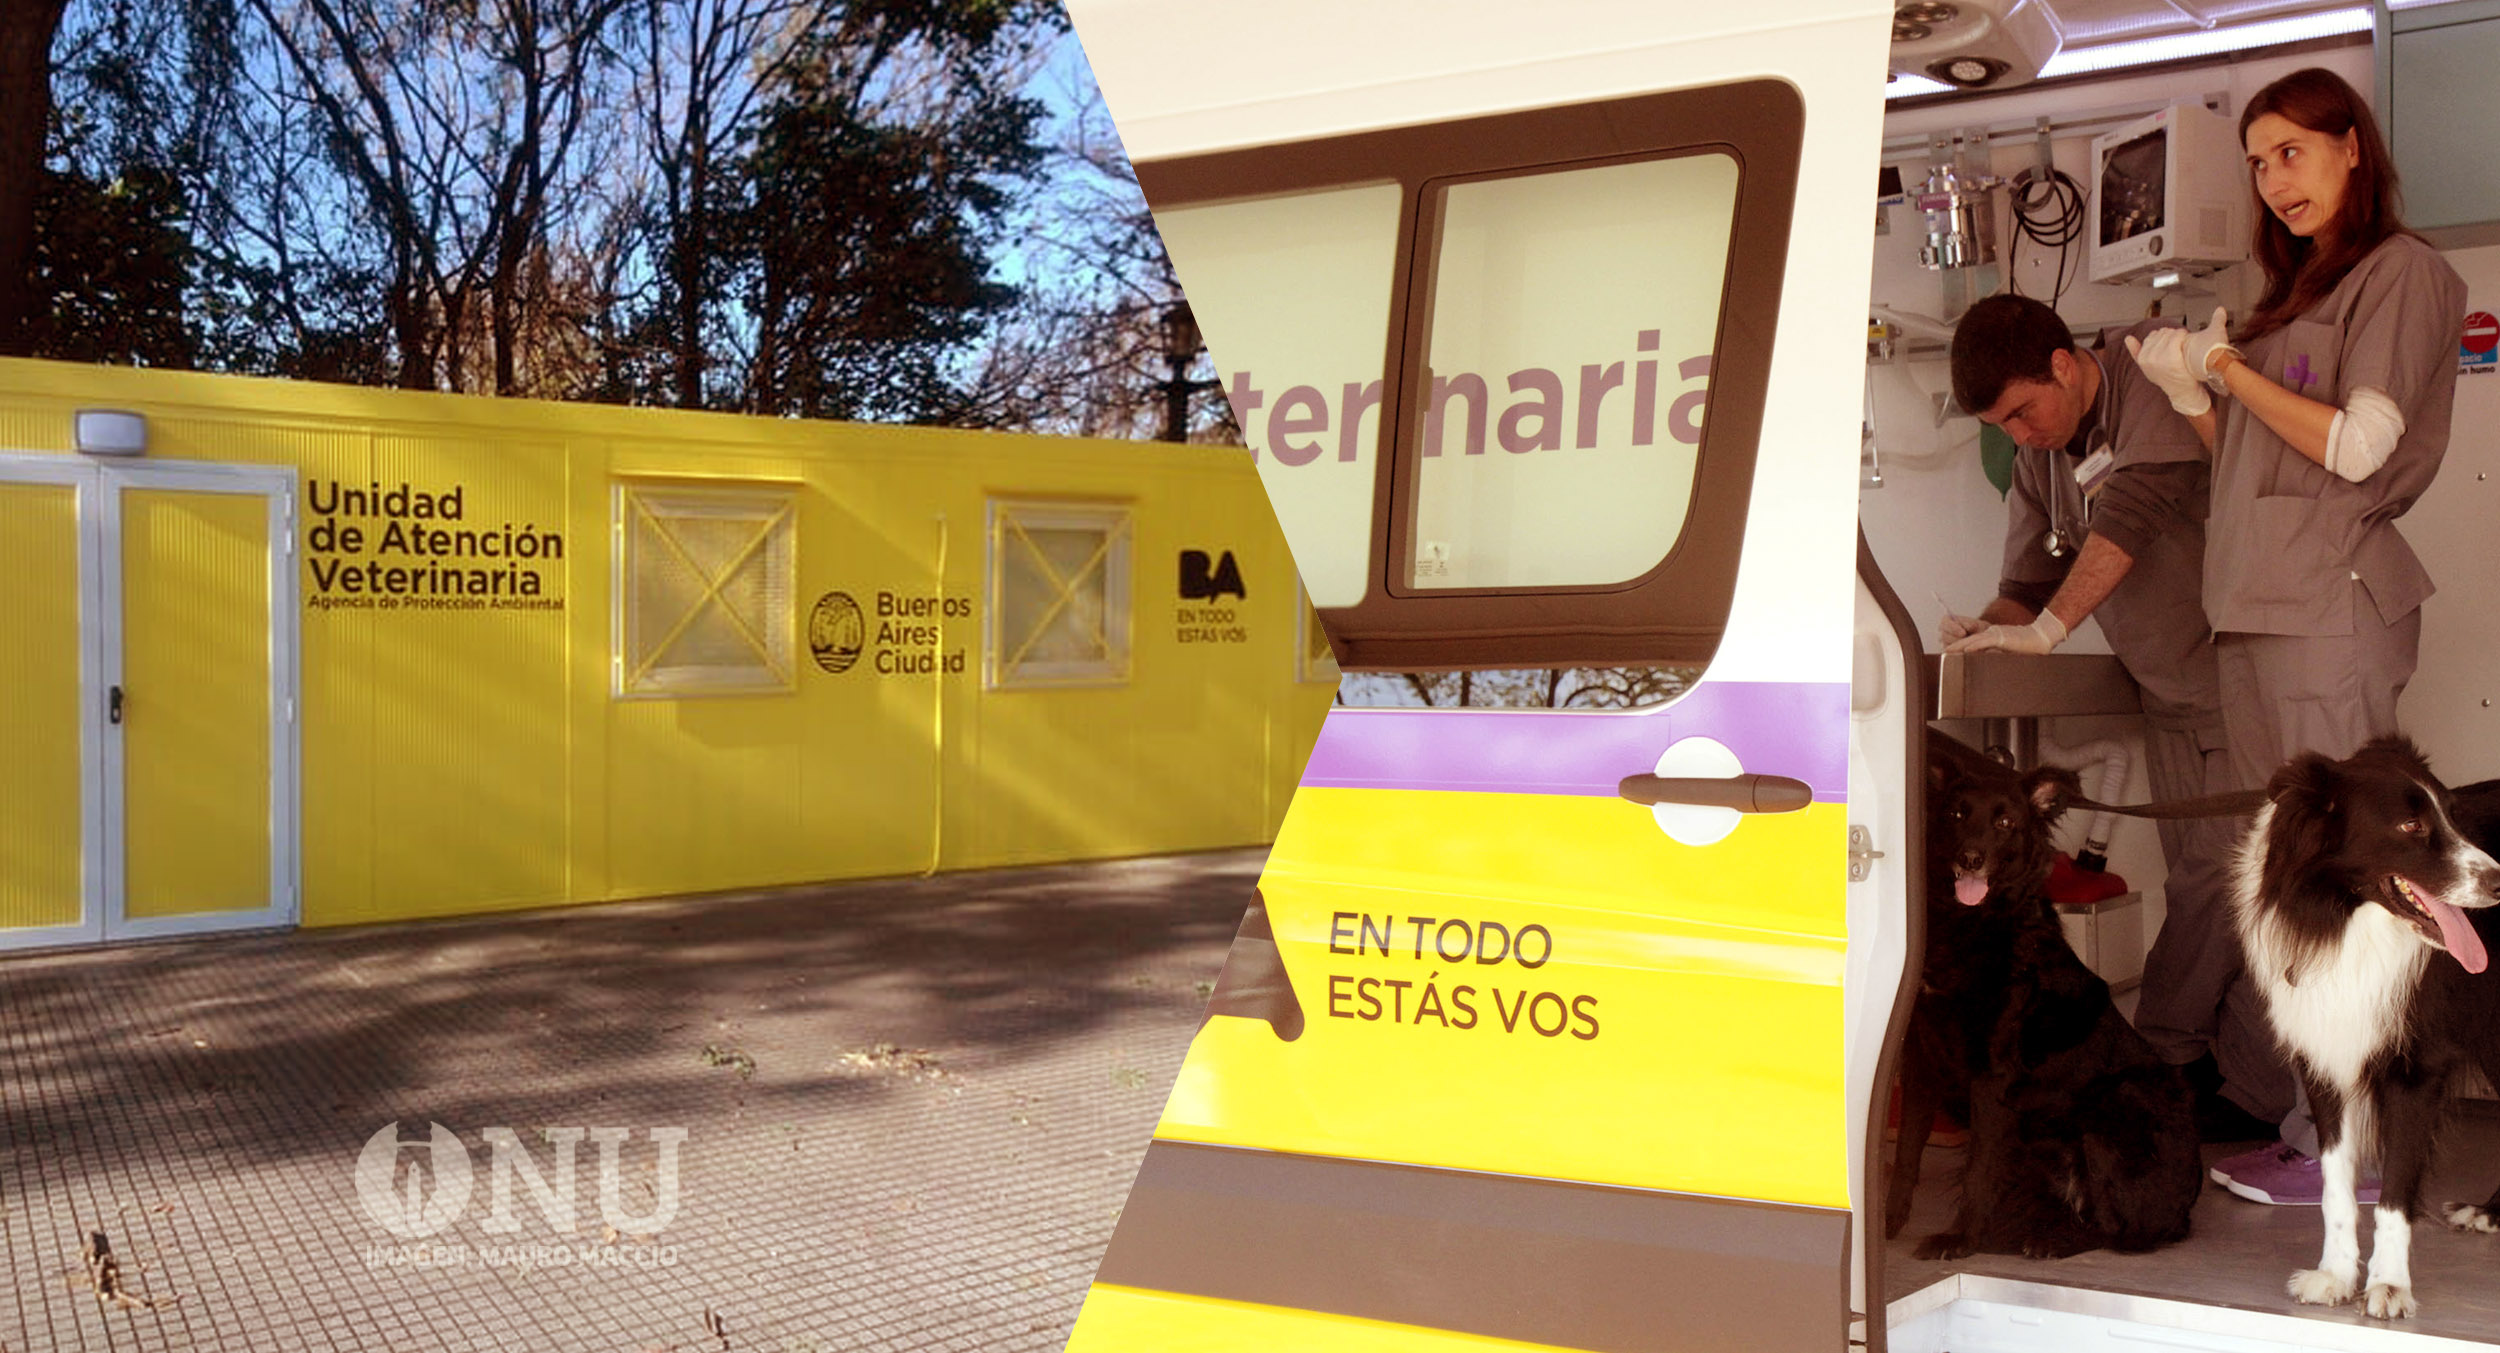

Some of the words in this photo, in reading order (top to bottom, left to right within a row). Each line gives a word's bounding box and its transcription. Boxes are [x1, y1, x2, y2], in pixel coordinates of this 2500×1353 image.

[2471, 366, 2495, 375] humo
[309, 480, 463, 520] Unidad
[309, 518, 364, 554] de
[378, 521, 564, 559] Atención
[309, 558, 541, 595] Veterinaria
[1179, 550, 1246, 605] BA
[308, 596, 376, 611] Agencia
[378, 596, 399, 609] de
[490, 597, 565, 611] Ambiental
[1178, 609, 1196, 623] EN
[1198, 609, 1236, 623] TODO
[876, 621, 939, 646] Aires
[1221, 627, 1247, 643] VOS
[1328, 911, 1393, 957] EN
[1406, 916, 1552, 969] TODO
[1328, 971, 1478, 1030] ESTÁS
[1492, 988, 1600, 1041] VOS
